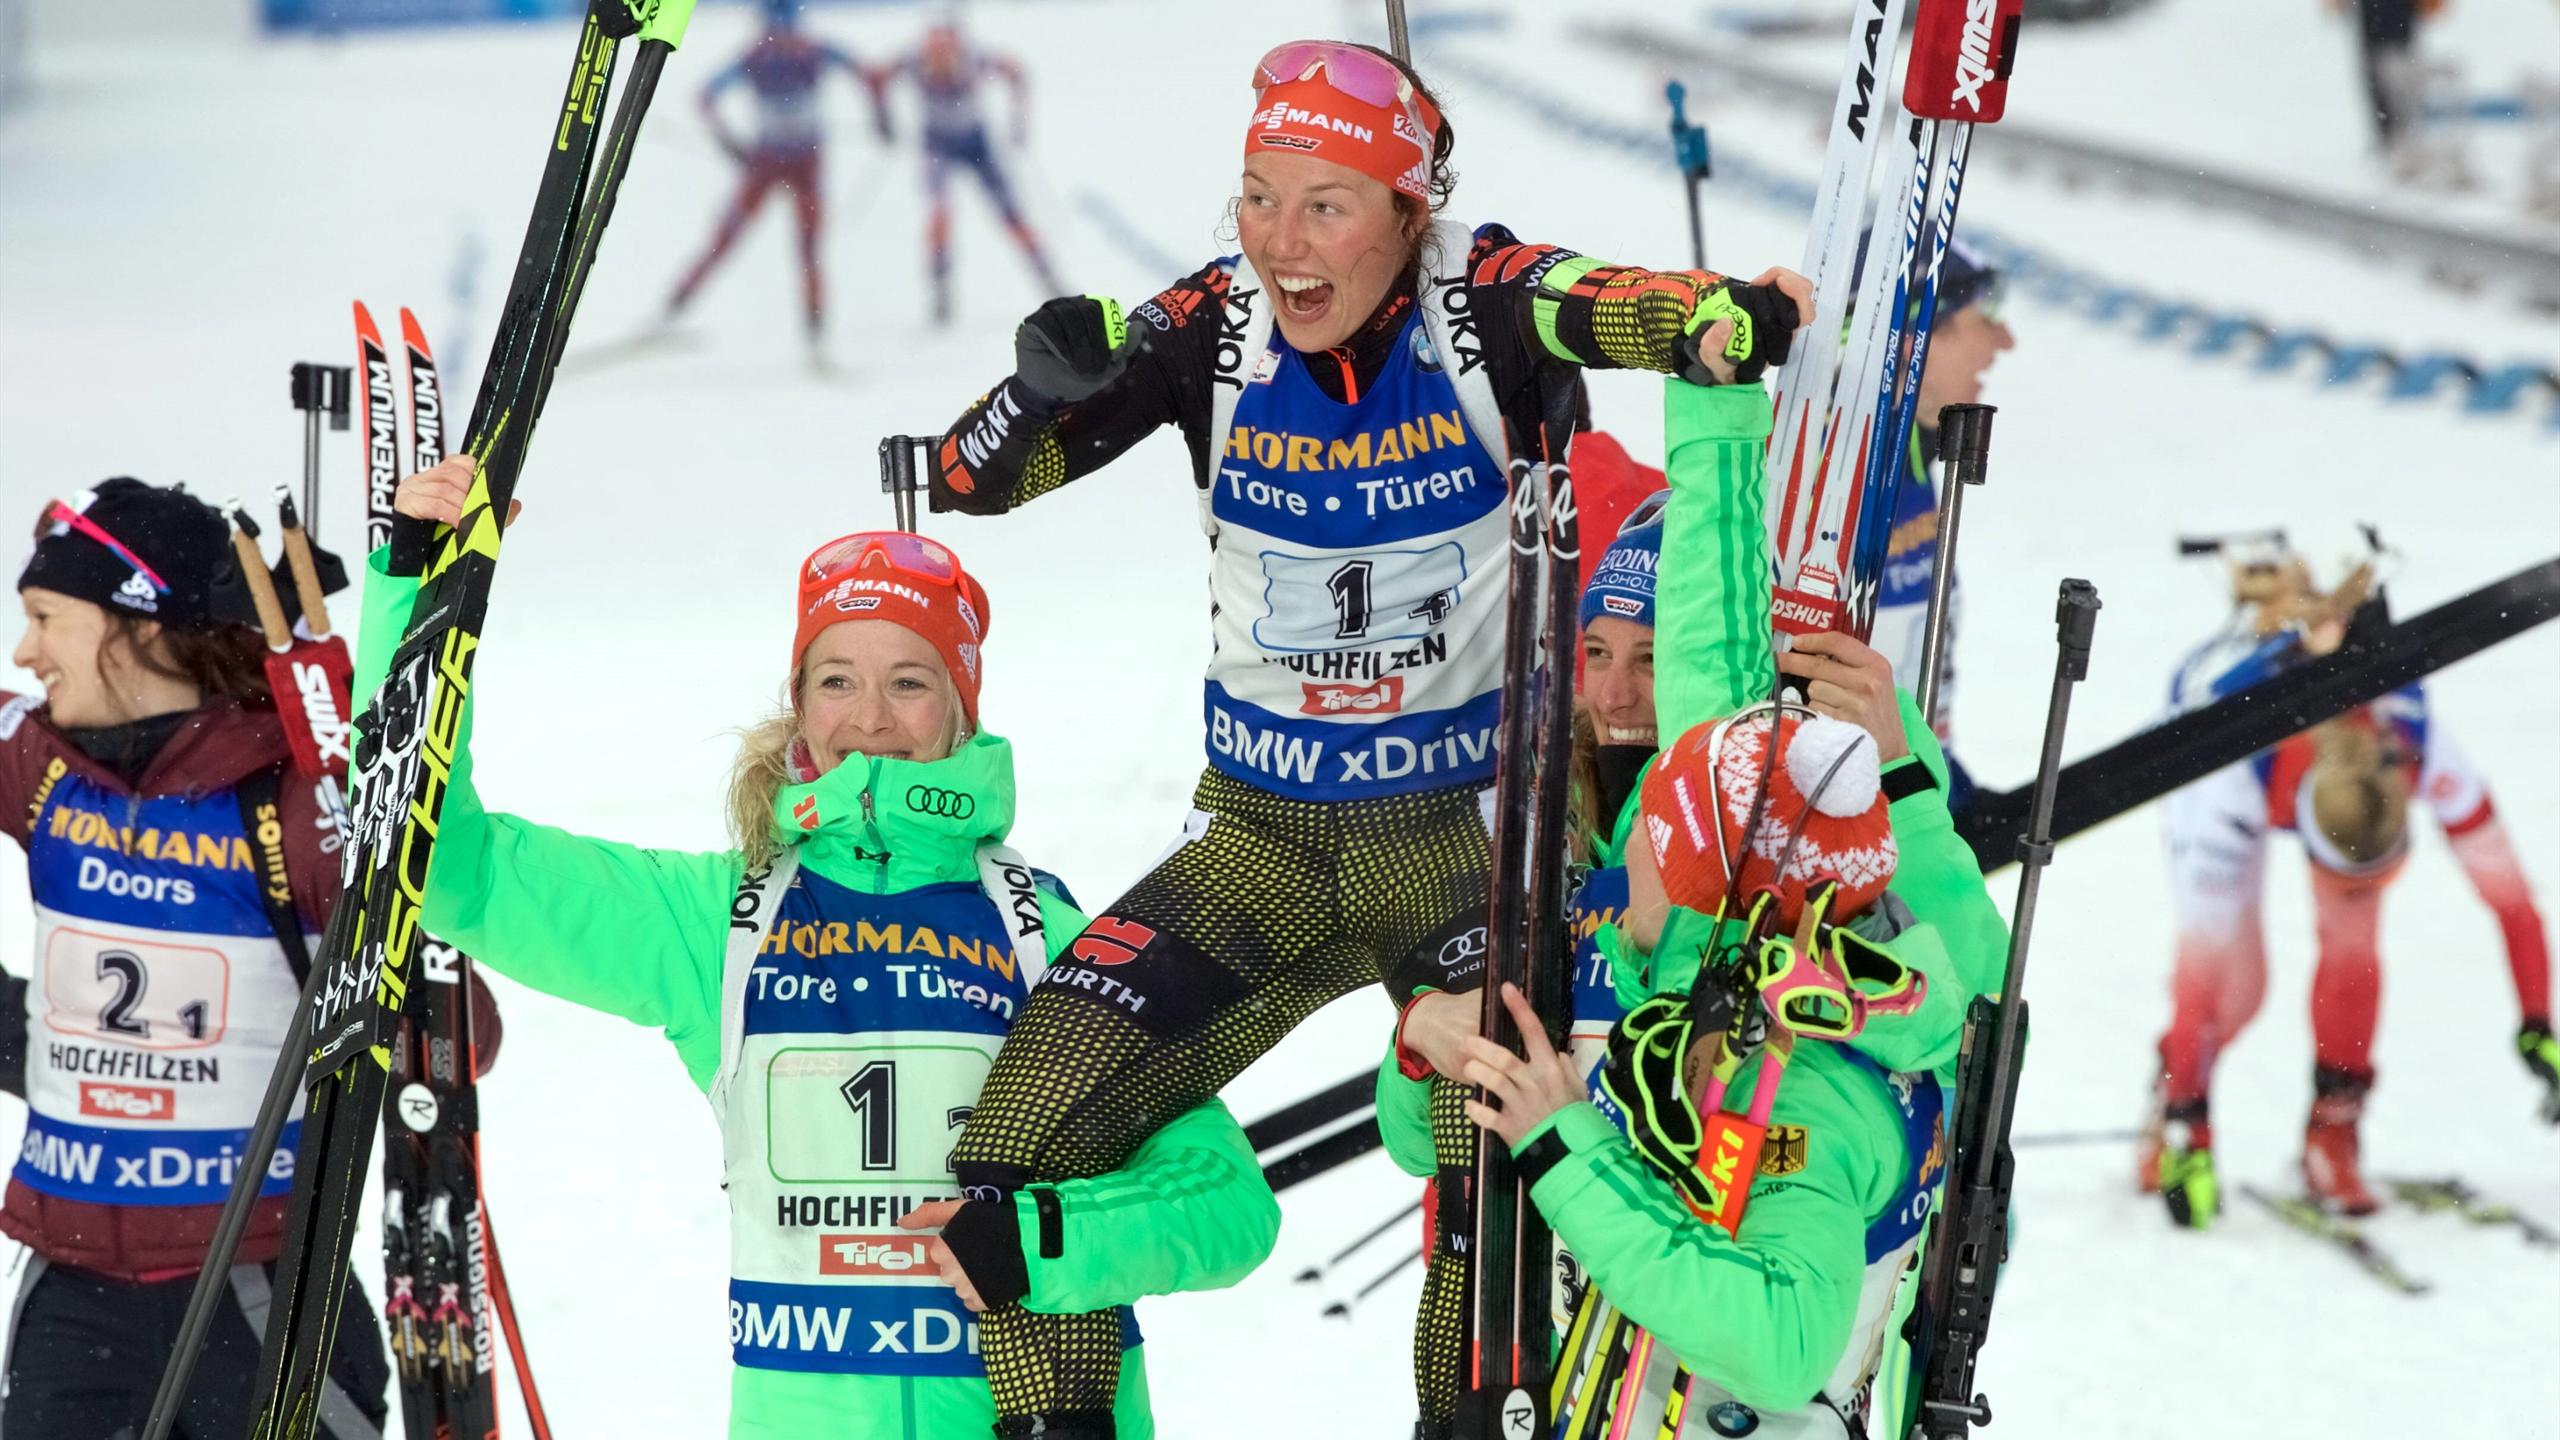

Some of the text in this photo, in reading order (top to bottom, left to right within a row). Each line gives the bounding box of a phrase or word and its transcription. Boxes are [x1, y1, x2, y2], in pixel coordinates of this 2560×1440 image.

[557, 13, 599, 151] FISC
[1847, 0, 1888, 143] MA
[367, 359, 397, 515] PREMIUM
[1223, 409, 1467, 473] HÖRMANN
[1220, 465, 1477, 518] Tore Türen
[1326, 560, 1452, 640] 1 4
[1262, 633, 1447, 681] OCHFILZEN
[1316, 684, 1392, 711] Tirol
[1211, 703, 1323, 784] BMW
[78, 856, 196, 905] Doors
[991, 857, 1045, 938] JOKA
[758, 918, 1016, 983] HÖRMANN
[96, 949, 209, 1040] 2 1
[752, 963, 1014, 1020] Tore Türen
[1038, 964, 1147, 1014] WÜRTH
[49, 1042, 220, 1083] HOCHFILZEN
[839, 1060, 896, 1172] 1
[22, 1129, 296, 1189] BMW xDrie
[465, 1199, 494, 1375] ROSSIGNOL
[833, 1240, 927, 1271] Tirol
[729, 1298, 853, 1354] BMW
